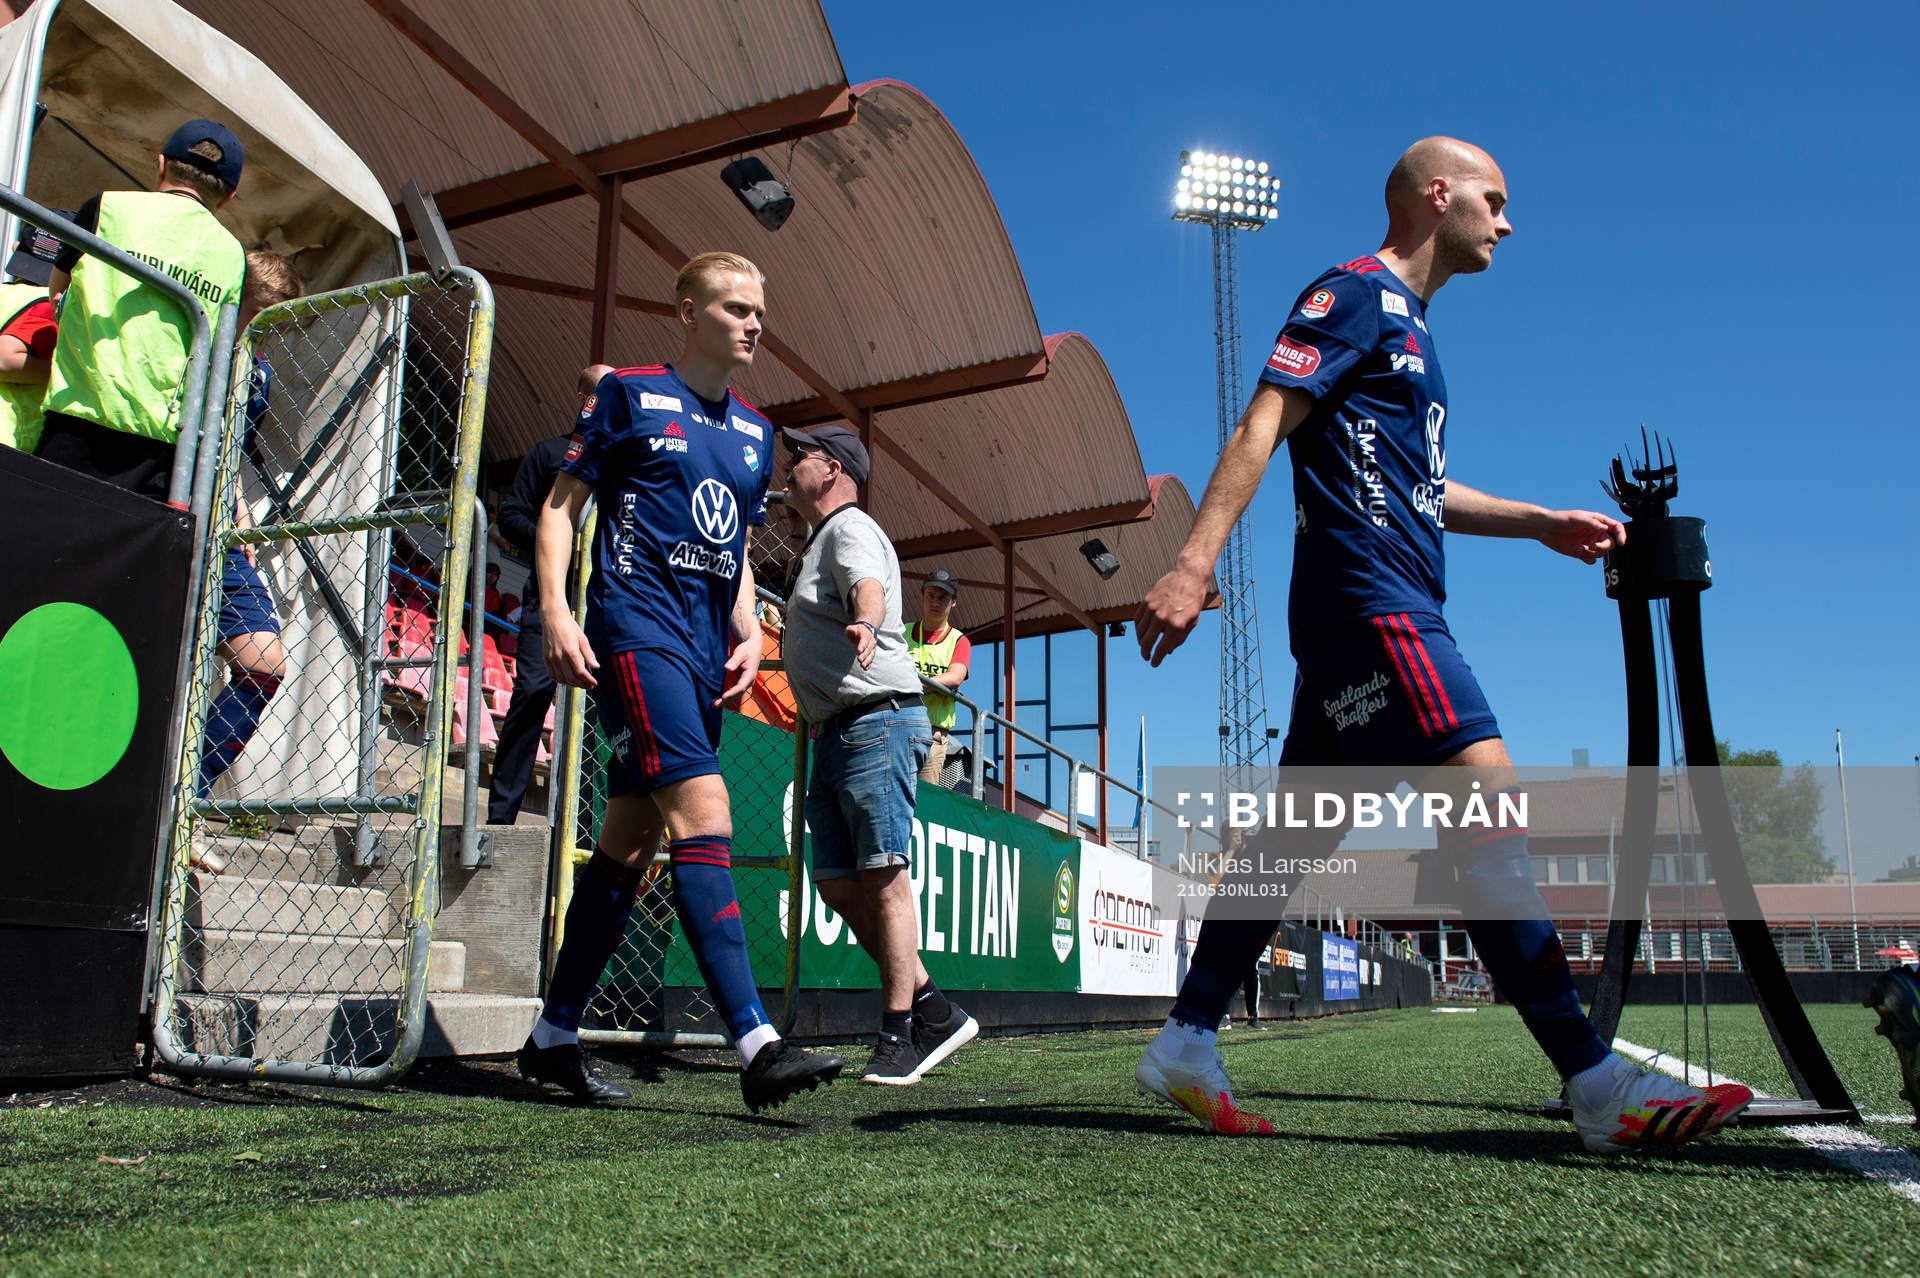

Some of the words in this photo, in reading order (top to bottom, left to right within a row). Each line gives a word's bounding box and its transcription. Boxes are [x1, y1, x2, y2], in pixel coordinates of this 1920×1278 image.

[1274, 342, 1316, 366] NIBET
[665, 437, 688, 448] INTER
[665, 444, 688, 454] SPORT
[618, 493, 637, 576] EMILSHUS
[1324, 671, 1390, 718] Smålands
[1335, 691, 1388, 731] Skafferi
